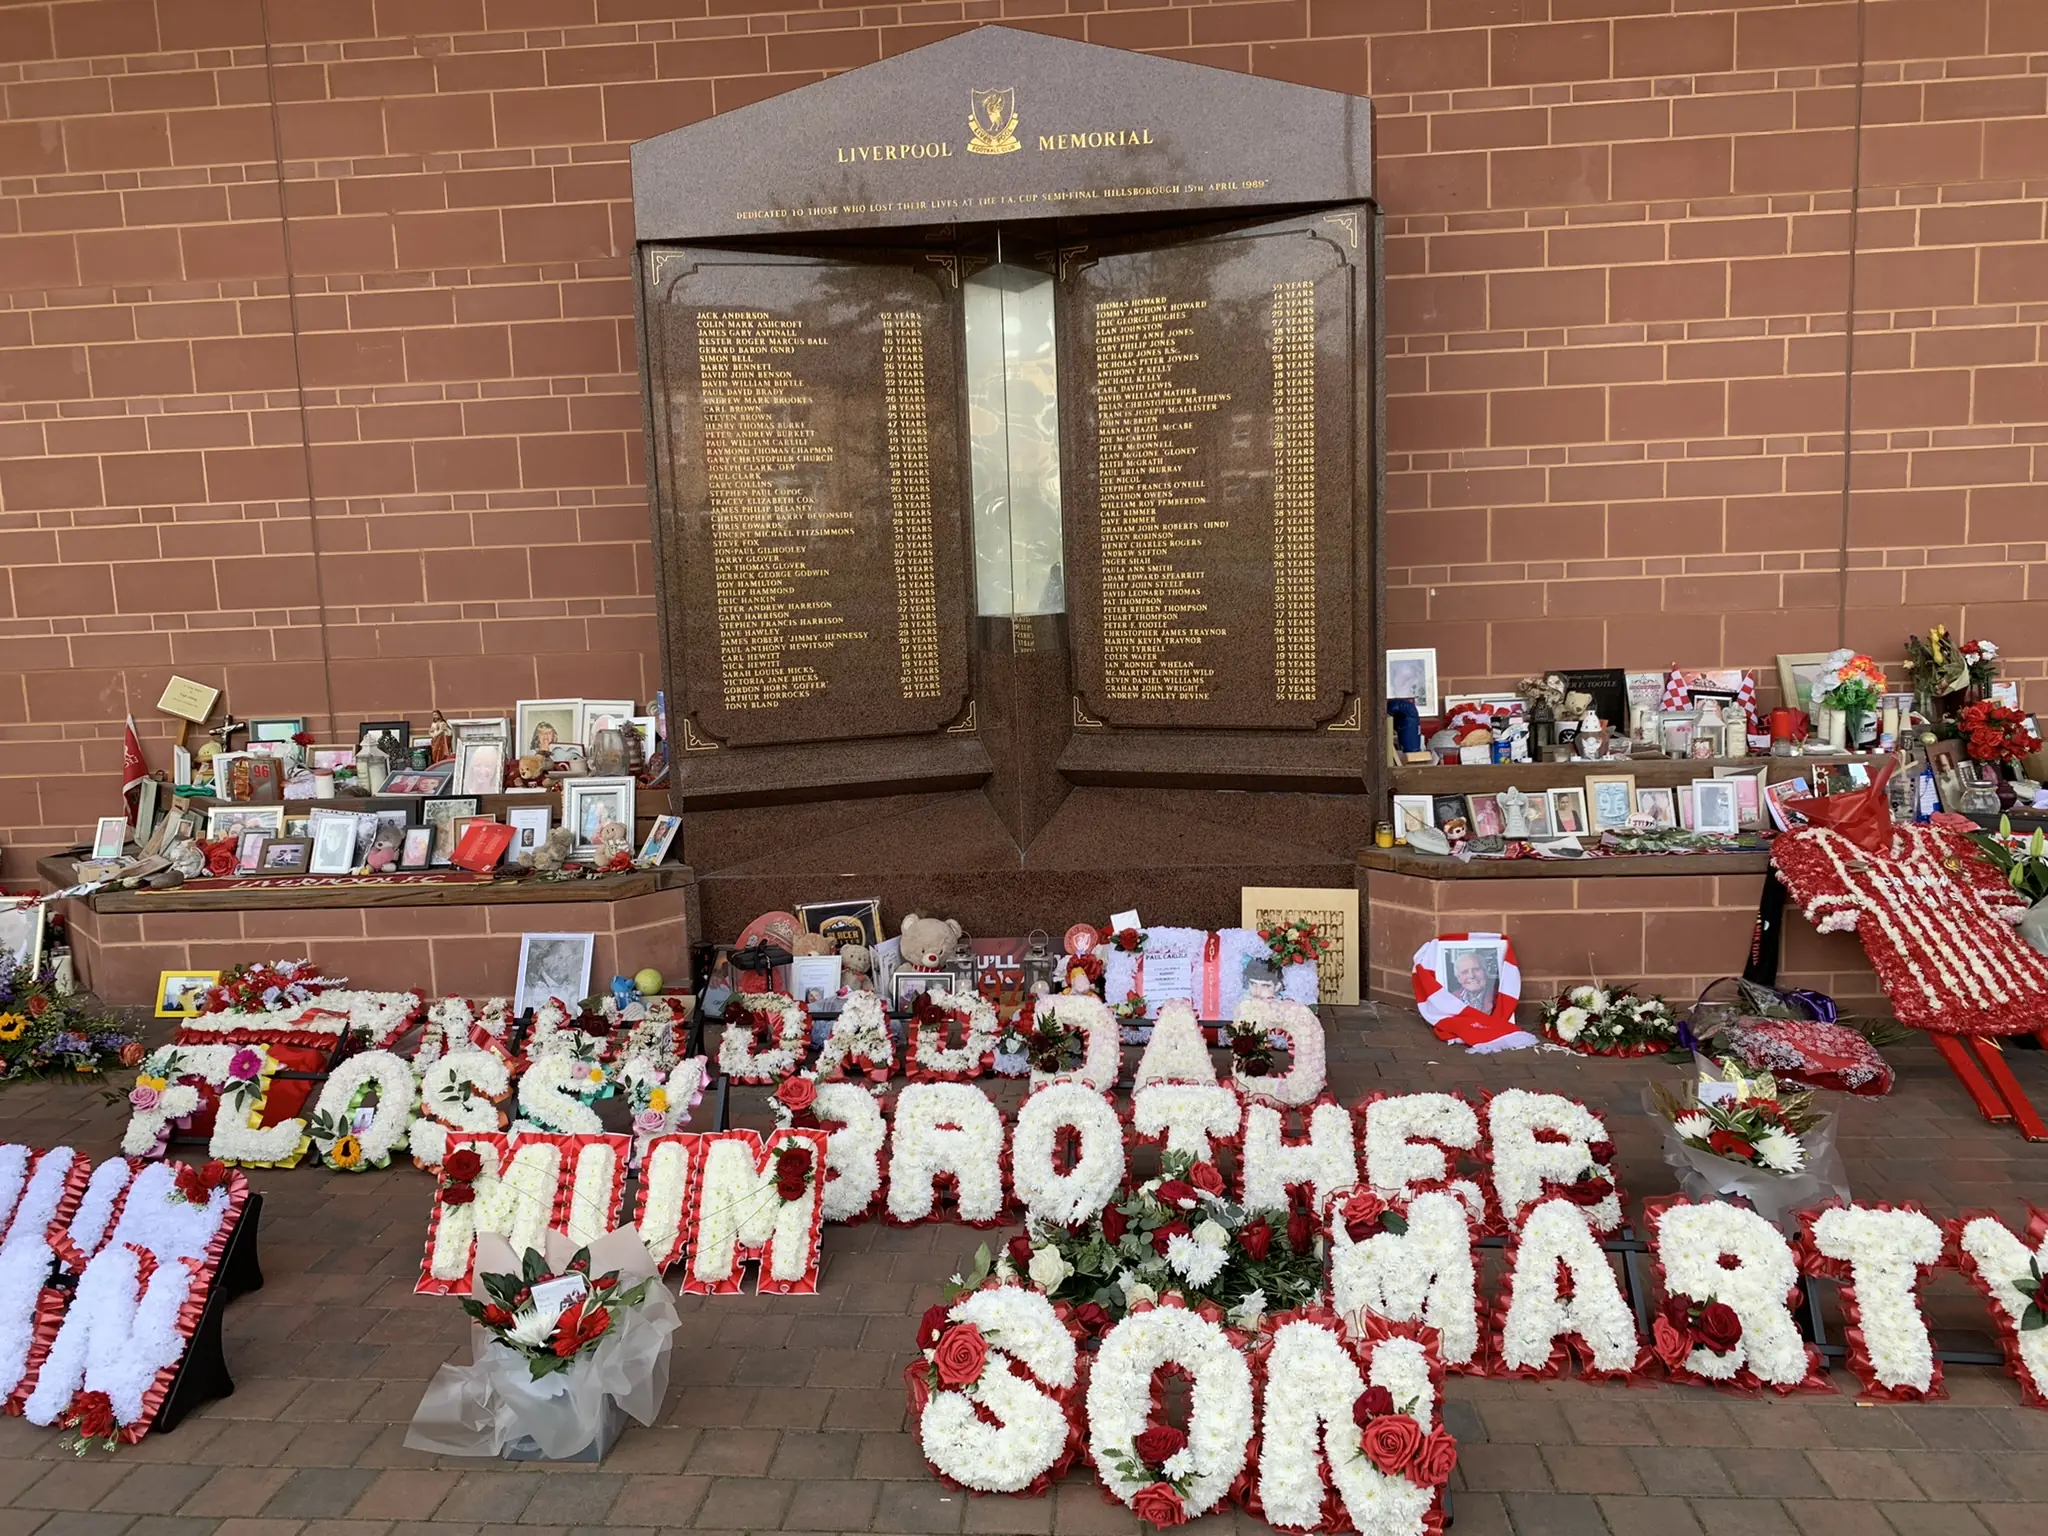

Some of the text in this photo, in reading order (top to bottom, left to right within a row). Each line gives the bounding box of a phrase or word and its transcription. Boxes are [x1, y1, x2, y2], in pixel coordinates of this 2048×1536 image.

[837, 129, 1154, 163] LIVERPOOL MEMORIAL
[736, 209, 787, 219] DEDICATED
[792, 208, 804, 217] TO
[808, 206, 839, 216] THOSE
[843, 204, 866, 213] WHO
[870, 203, 893, 212] LOST
[898, 201, 927, 210] THEIR
[931, 199, 958, 208] LIVES
[962, 198, 973, 207] AT
[979, 197, 997, 205] THE
[1019, 194, 1038, 203] CUP
[1103, 185, 1180, 198] HILLSBOROUGH
[1208, 182, 1238, 191] APRIL
[1285, 288, 1313, 298] YEARS
[1285, 306, 1314, 316] YEARS
[897, 370, 924, 378] YEARS
[1286, 377, 1314, 387] YEARS
[1286, 482, 1314, 490] YEARS
[1287, 516, 1314, 524] YEARS
[1287, 559, 1315, 567] YEARS
[908, 580, 935, 588] YEARS
[909, 596, 935, 604] YEARS
[913, 667, 939, 675] YEARS
[914, 682, 940, 690] YEARS
[915, 690, 940, 698] YEARS
[252, 765, 270, 777] 96
[230, 877, 395, 888] LIVERPOOL
[425, 1135, 820, 1284] MUM
[920, 1286, 1438, 1533] SON
